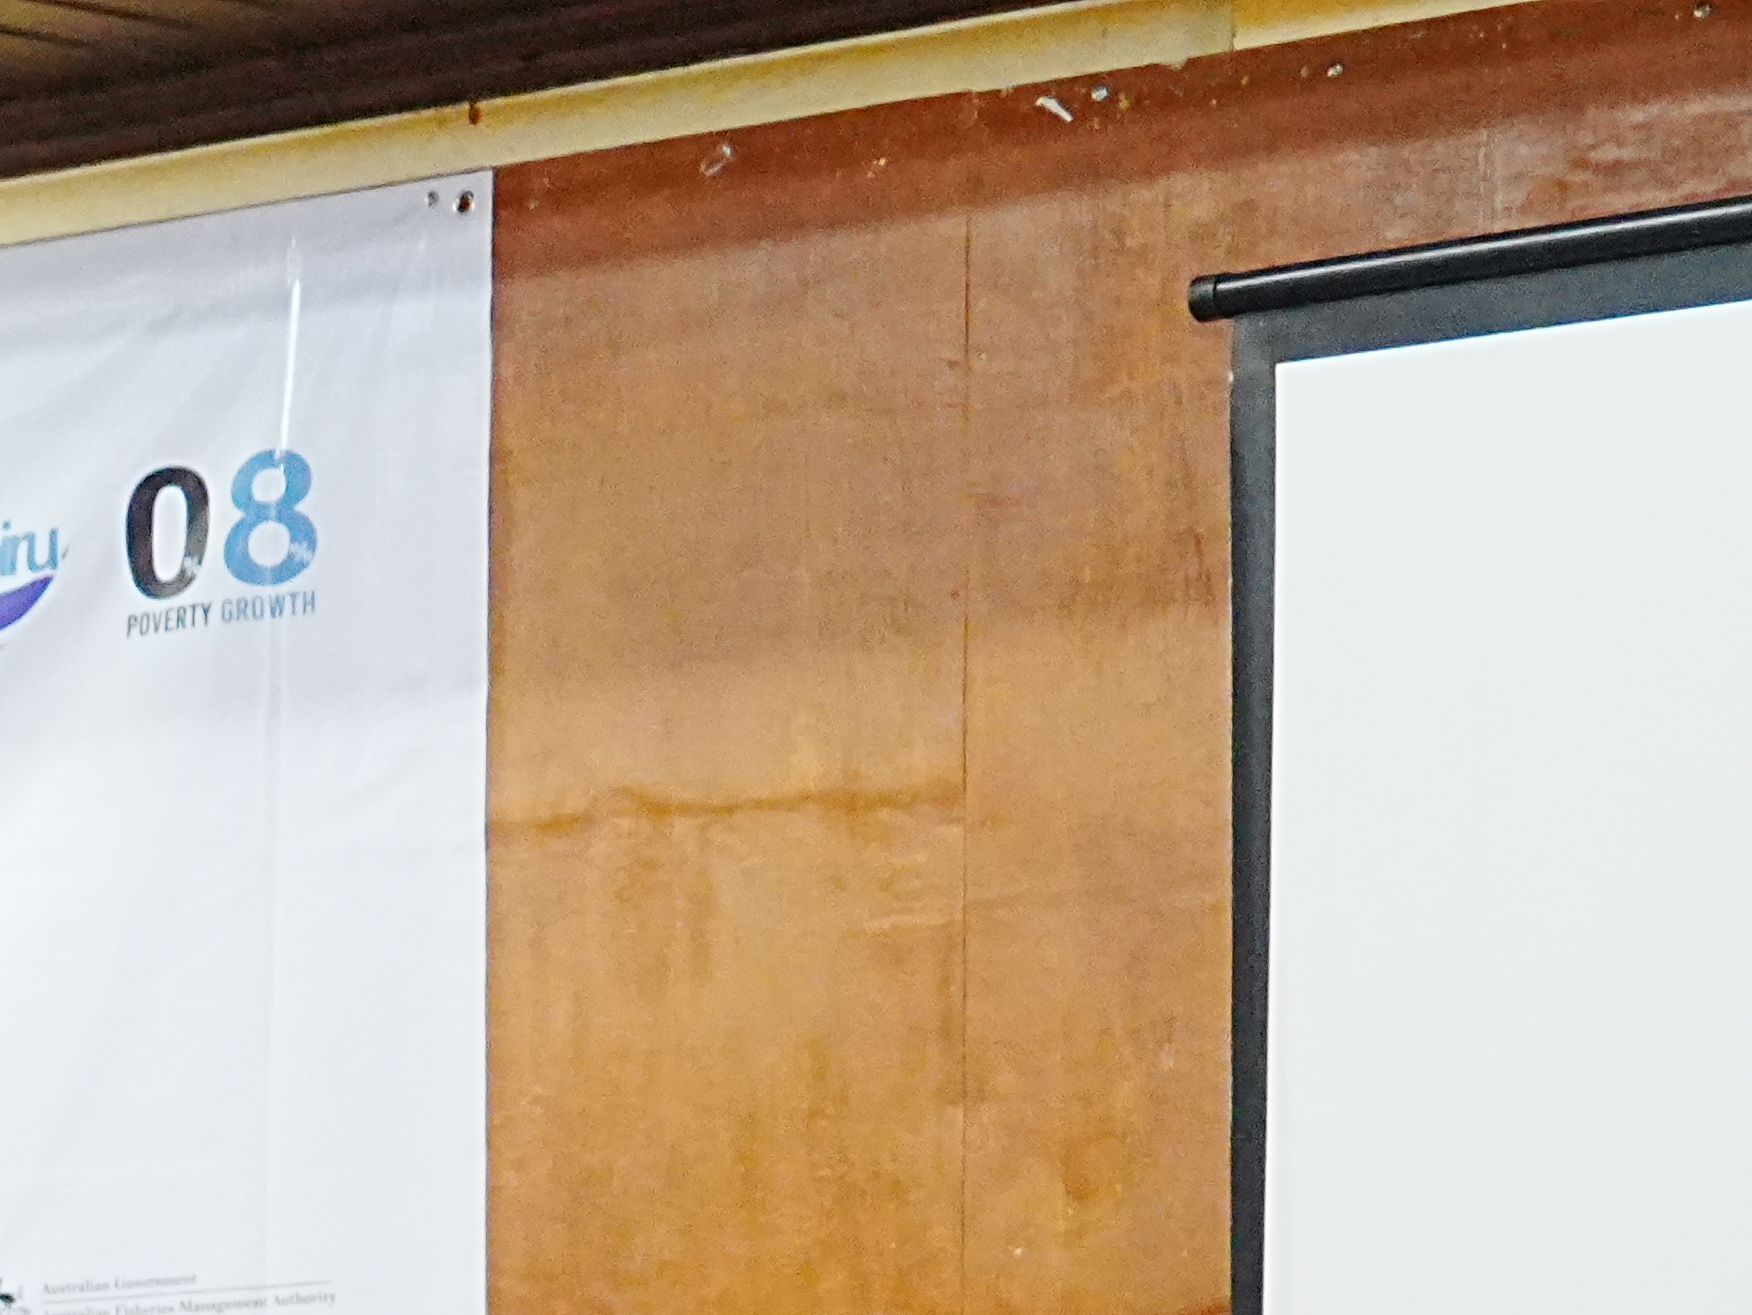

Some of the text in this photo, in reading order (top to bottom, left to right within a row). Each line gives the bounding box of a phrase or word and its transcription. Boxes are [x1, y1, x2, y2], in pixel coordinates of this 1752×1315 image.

[126, 591, 317, 639] POVERTY GROWTH
[42, 1273, 197, 1296] Australian Government
[179, 1295, 268, 1315] Management
[272, 1289, 337, 1309] Authority
